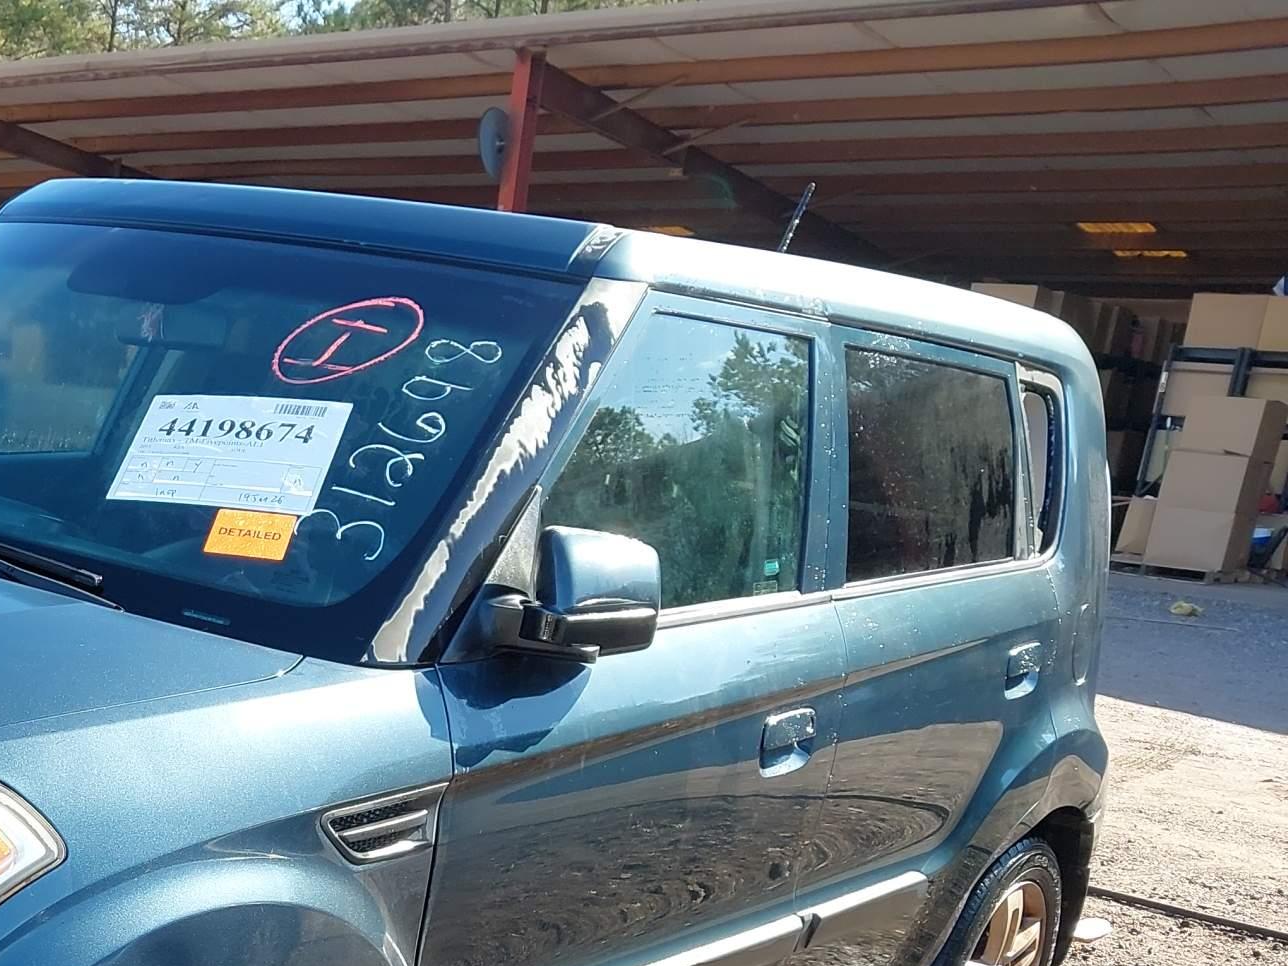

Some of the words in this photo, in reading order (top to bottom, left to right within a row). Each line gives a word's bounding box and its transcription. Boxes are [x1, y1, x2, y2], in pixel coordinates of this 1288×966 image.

[158, 417, 316, 444] 44198674
[294, 338, 503, 561] 312698
[218, 526, 282, 542] DETAILED
